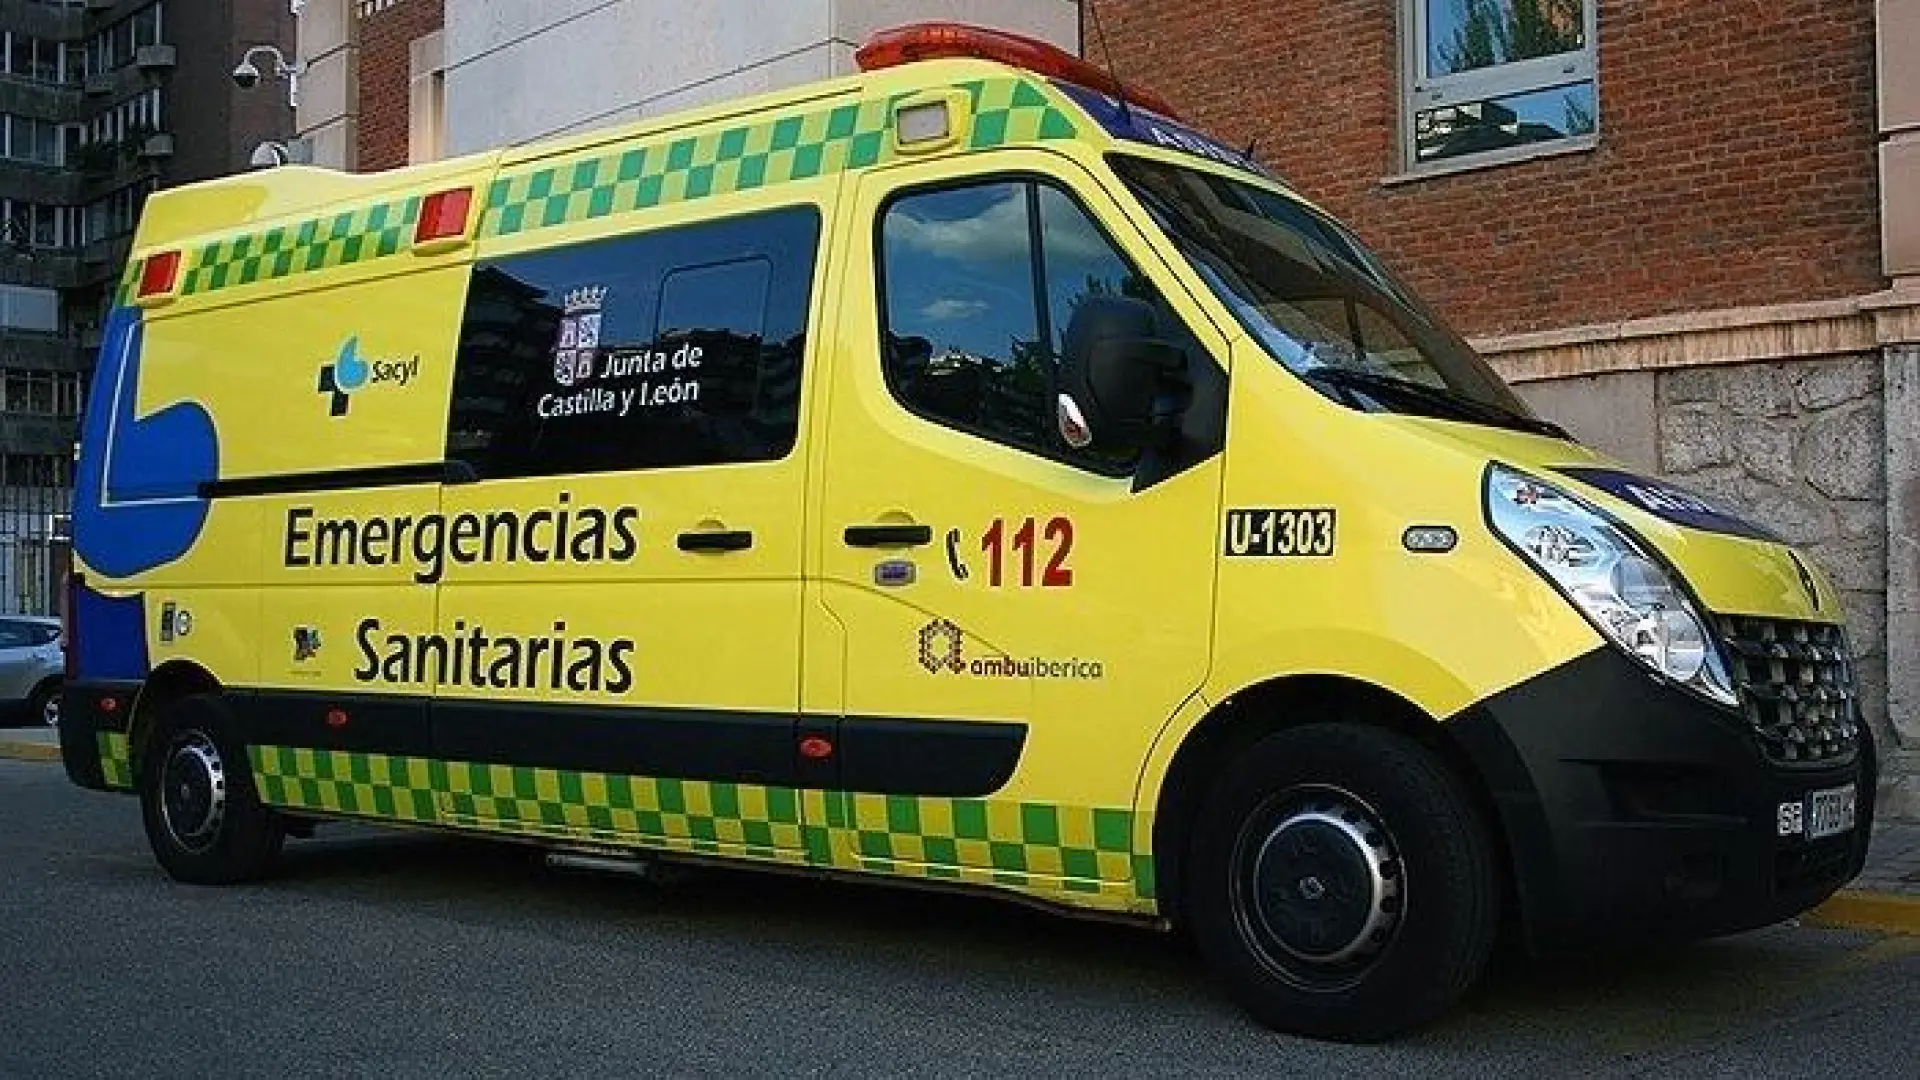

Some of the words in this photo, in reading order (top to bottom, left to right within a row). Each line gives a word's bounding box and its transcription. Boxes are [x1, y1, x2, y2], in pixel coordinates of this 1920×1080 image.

[372, 355, 419, 387] Sacyl
[600, 350, 667, 378] Junta
[672, 342, 703, 370] de
[537, 387, 615, 419] Castilla
[619, 387, 636, 417] y
[639, 377, 699, 406] León
[284, 491, 638, 585] Emergencias
[980, 515, 1074, 587] 112
[1229, 510, 1332, 555] U-1303
[353, 618, 635, 694] Sanitarias
[970, 655, 1103, 678] ambuiberica
